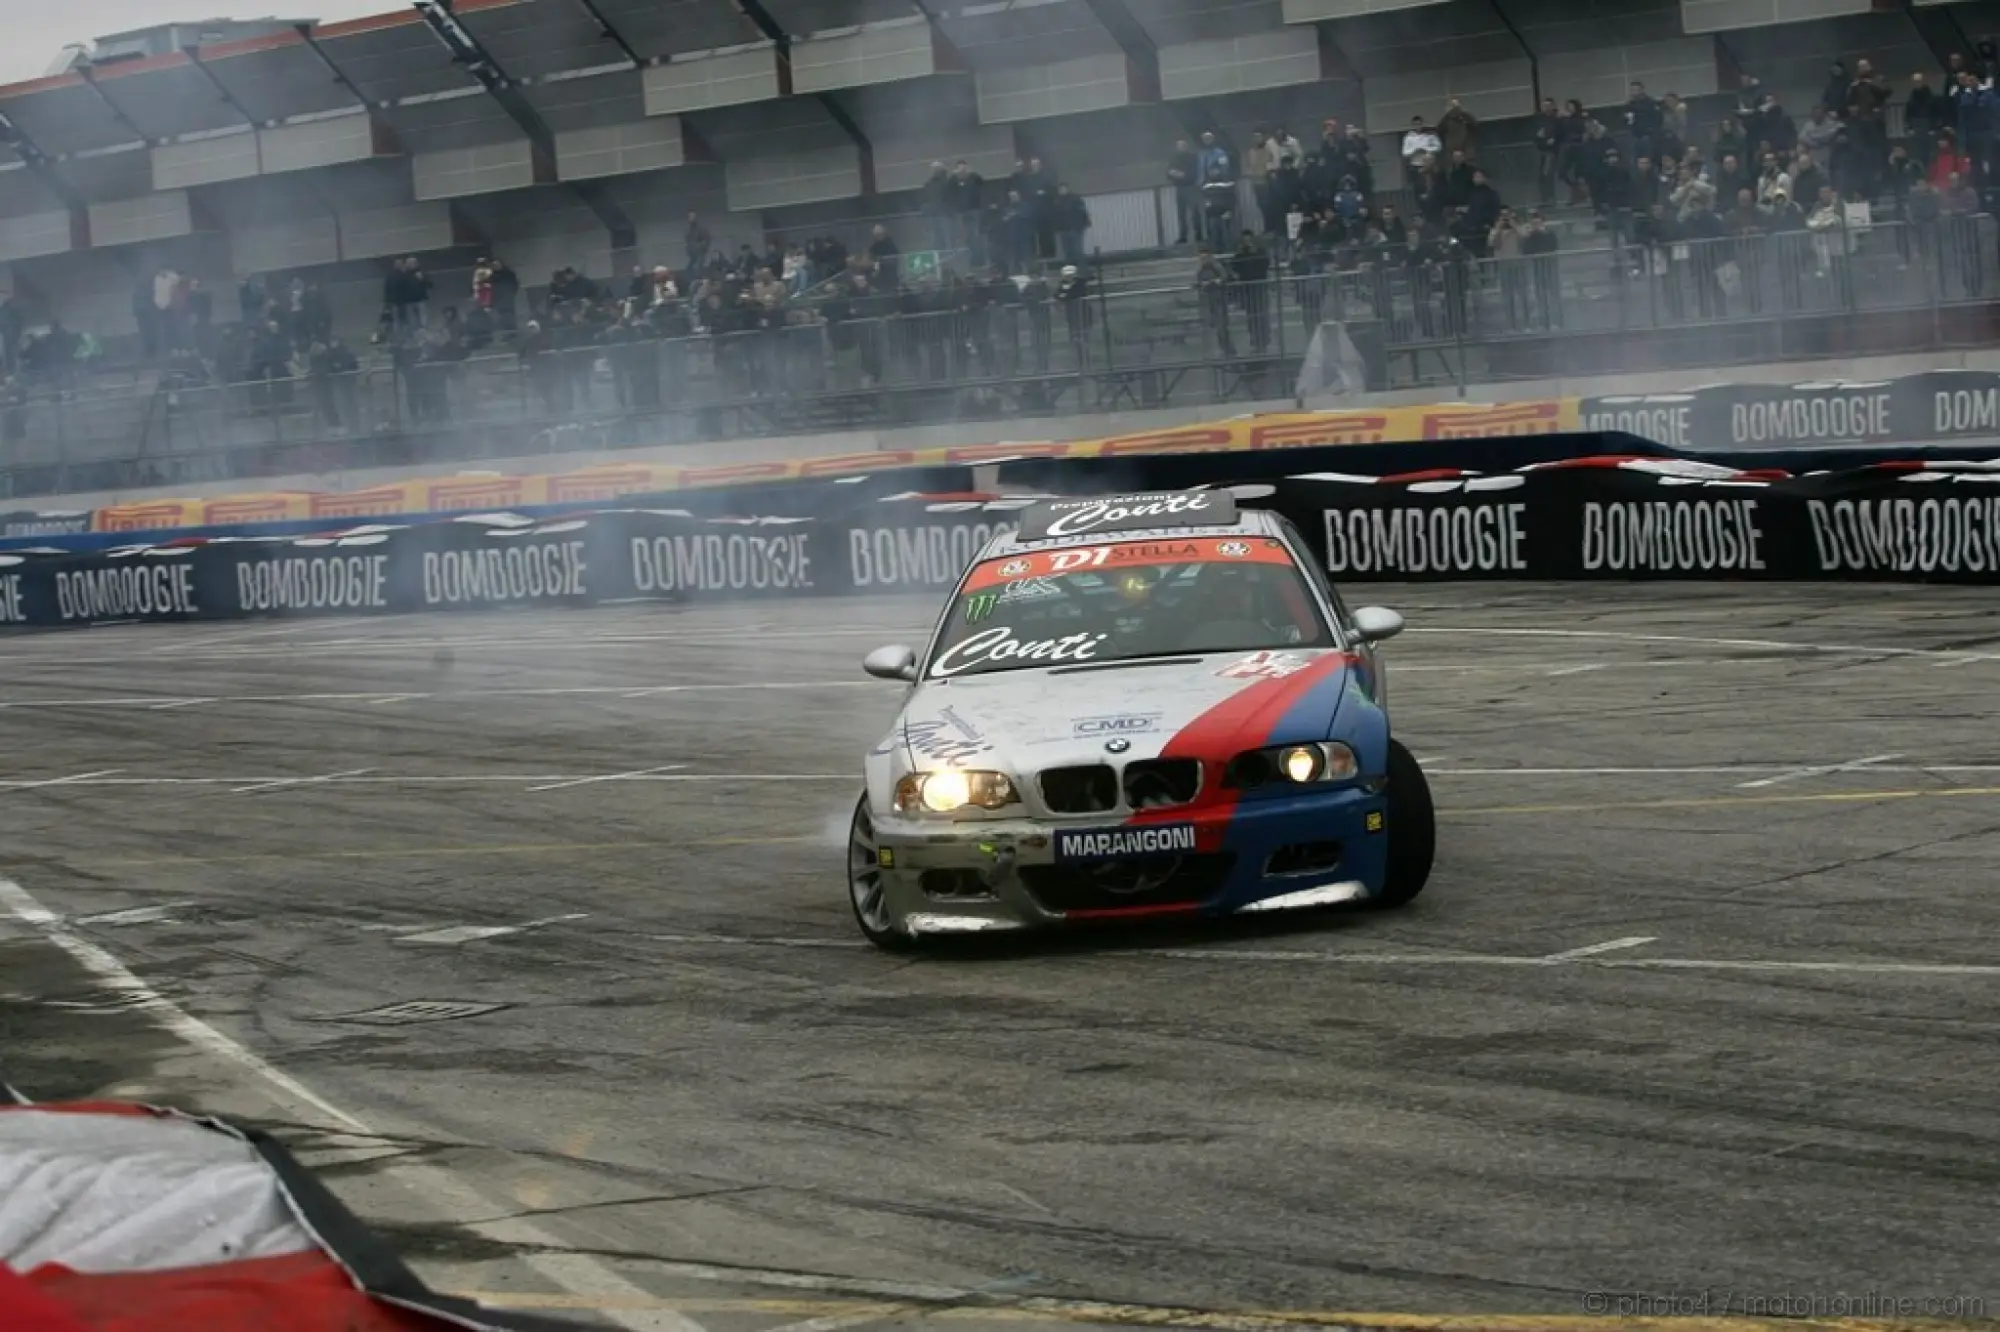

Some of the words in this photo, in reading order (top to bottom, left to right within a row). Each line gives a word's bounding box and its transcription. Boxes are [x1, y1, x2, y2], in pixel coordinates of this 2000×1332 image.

[1732, 395, 1891, 441] BOMBOOGIE
[1047, 484, 1212, 535] Conti
[1583, 500, 1766, 570] BOMBOOGIE
[631, 533, 814, 591] BOMBOOGIE
[1049, 547, 1112, 570] D1
[1324, 503, 1528, 573] BOMBOOGIE
[0, 574, 26, 621] IE
[56, 564, 199, 619] BOMBOOGIE
[237, 555, 388, 610] BOMBOOGIE
[423, 541, 587, 603] BOMBOOGIE
[931, 626, 1108, 676] Conti
[1062, 826, 1196, 856] MARANGONI
